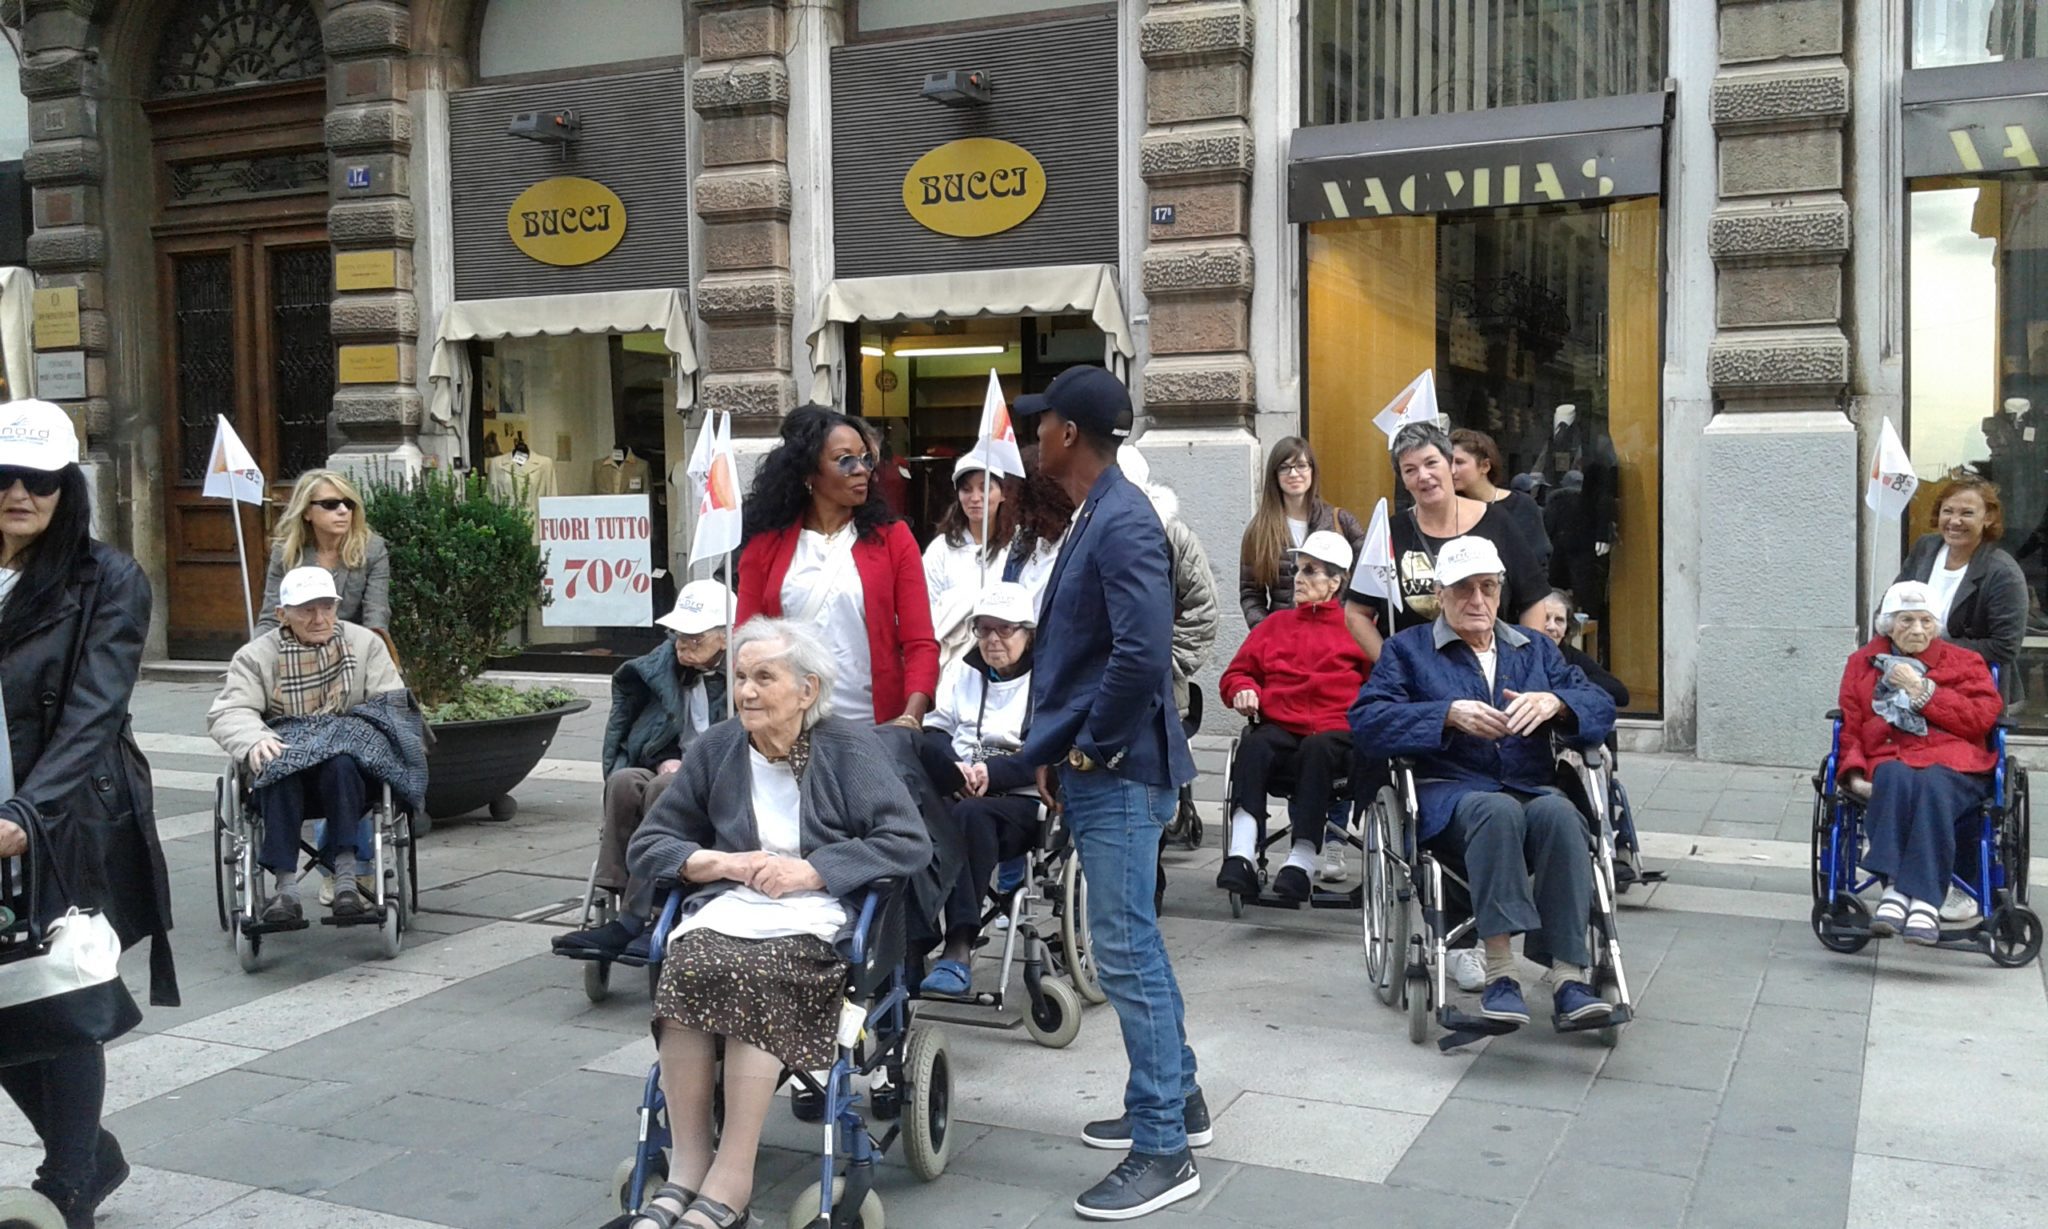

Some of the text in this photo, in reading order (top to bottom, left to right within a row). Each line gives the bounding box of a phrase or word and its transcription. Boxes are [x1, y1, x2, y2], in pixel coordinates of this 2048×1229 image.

[352, 168, 365, 183] 17
[540, 516, 650, 541] FUORI TUTTO
